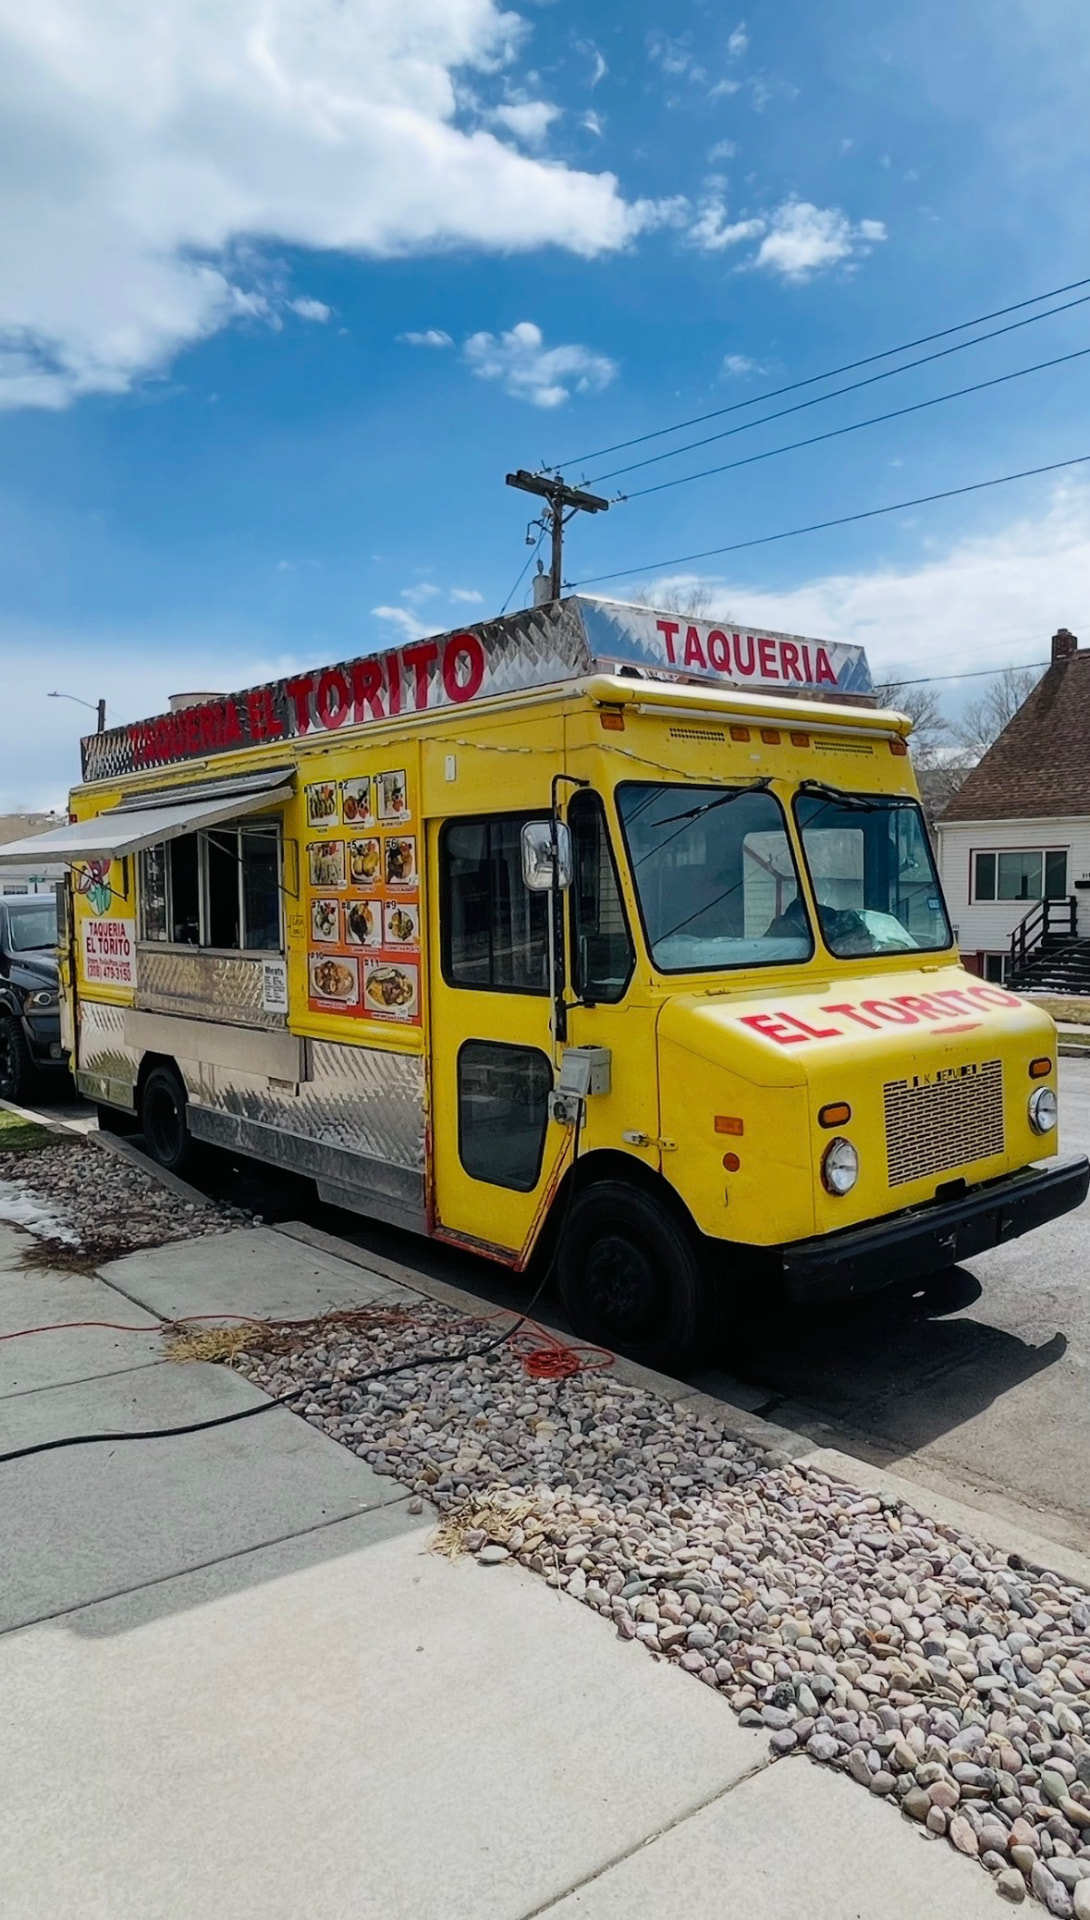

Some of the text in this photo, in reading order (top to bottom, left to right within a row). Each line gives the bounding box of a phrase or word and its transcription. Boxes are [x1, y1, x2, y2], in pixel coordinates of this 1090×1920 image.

[655, 619, 838, 685] TAQUERIA
[127, 633, 485, 764] TAQUERIA EL TORITO
[338, 780, 349, 790] #2
[373, 774, 383, 784] #3
[306, 839, 397, 852] #4 #5 #6
[311, 900, 397, 911] #7 #8 #9
[89, 922, 126, 937] TAQUERIA
[86, 937, 130, 956] EL TORITO
[310, 951, 380, 968] #10 #11
[740, 986, 1022, 1045] EL TORITO
